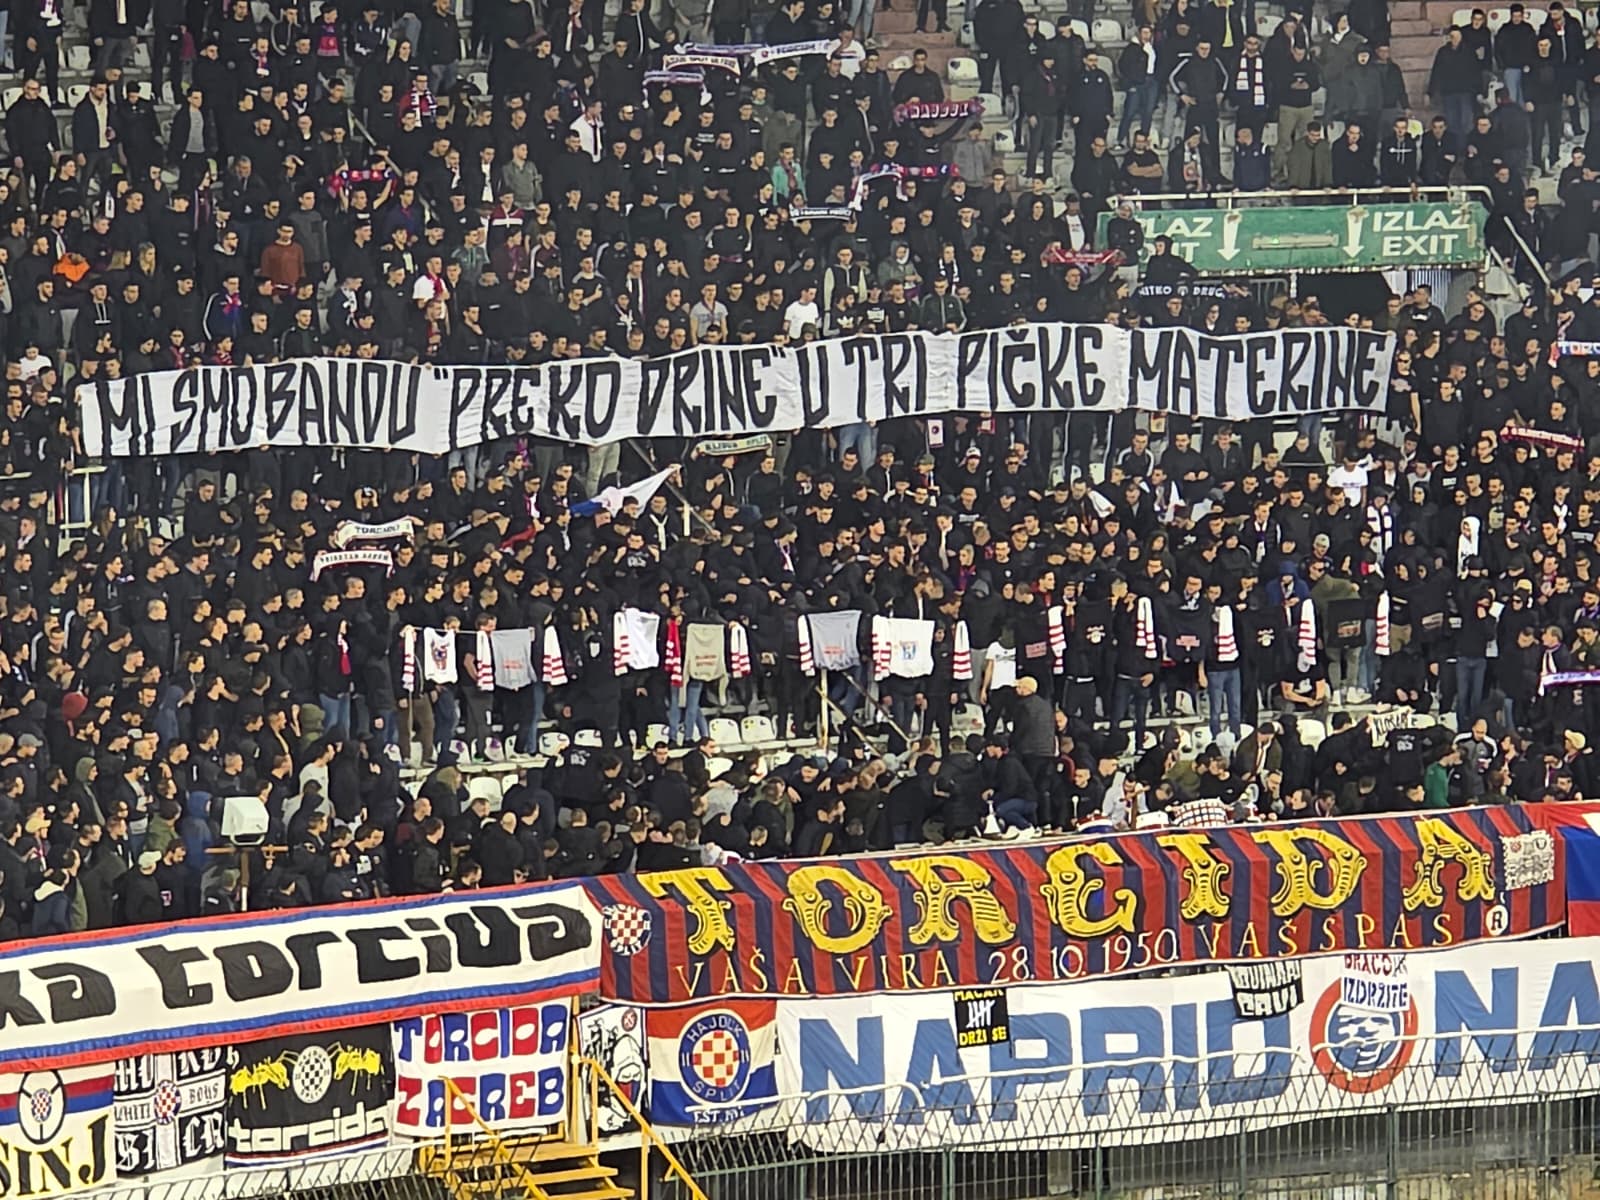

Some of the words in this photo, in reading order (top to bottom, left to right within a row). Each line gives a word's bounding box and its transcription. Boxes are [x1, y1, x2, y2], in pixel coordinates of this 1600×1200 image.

[1373, 210, 1469, 233] IZLAZ
[1382, 234, 1459, 257] EXIT
[96, 376, 154, 456] MI
[171, 366, 257, 449] SMO
[637, 345, 786, 436] DRINE"
[797, 345, 829, 427] U
[841, 334, 928, 420] TRI
[956, 325, 1106, 410] PIČKE
[1127, 328, 1388, 417] MATERINE
[636, 818, 1496, 955] TORCIDA
[676, 945, 809, 998] VAŠA
[836, 949, 957, 991] VIRA
[988, 945, 1035, 985] 28.
[1199, 915, 1298, 960] VAŠ
[1319, 913, 1454, 951] SPAS
[393, 1003, 567, 1064] TORCIDA
[991, 1026, 1008, 1042] SE
[396, 1066, 564, 1128] ZAGREB
[691, 1082, 741, 1102] SPLIT
